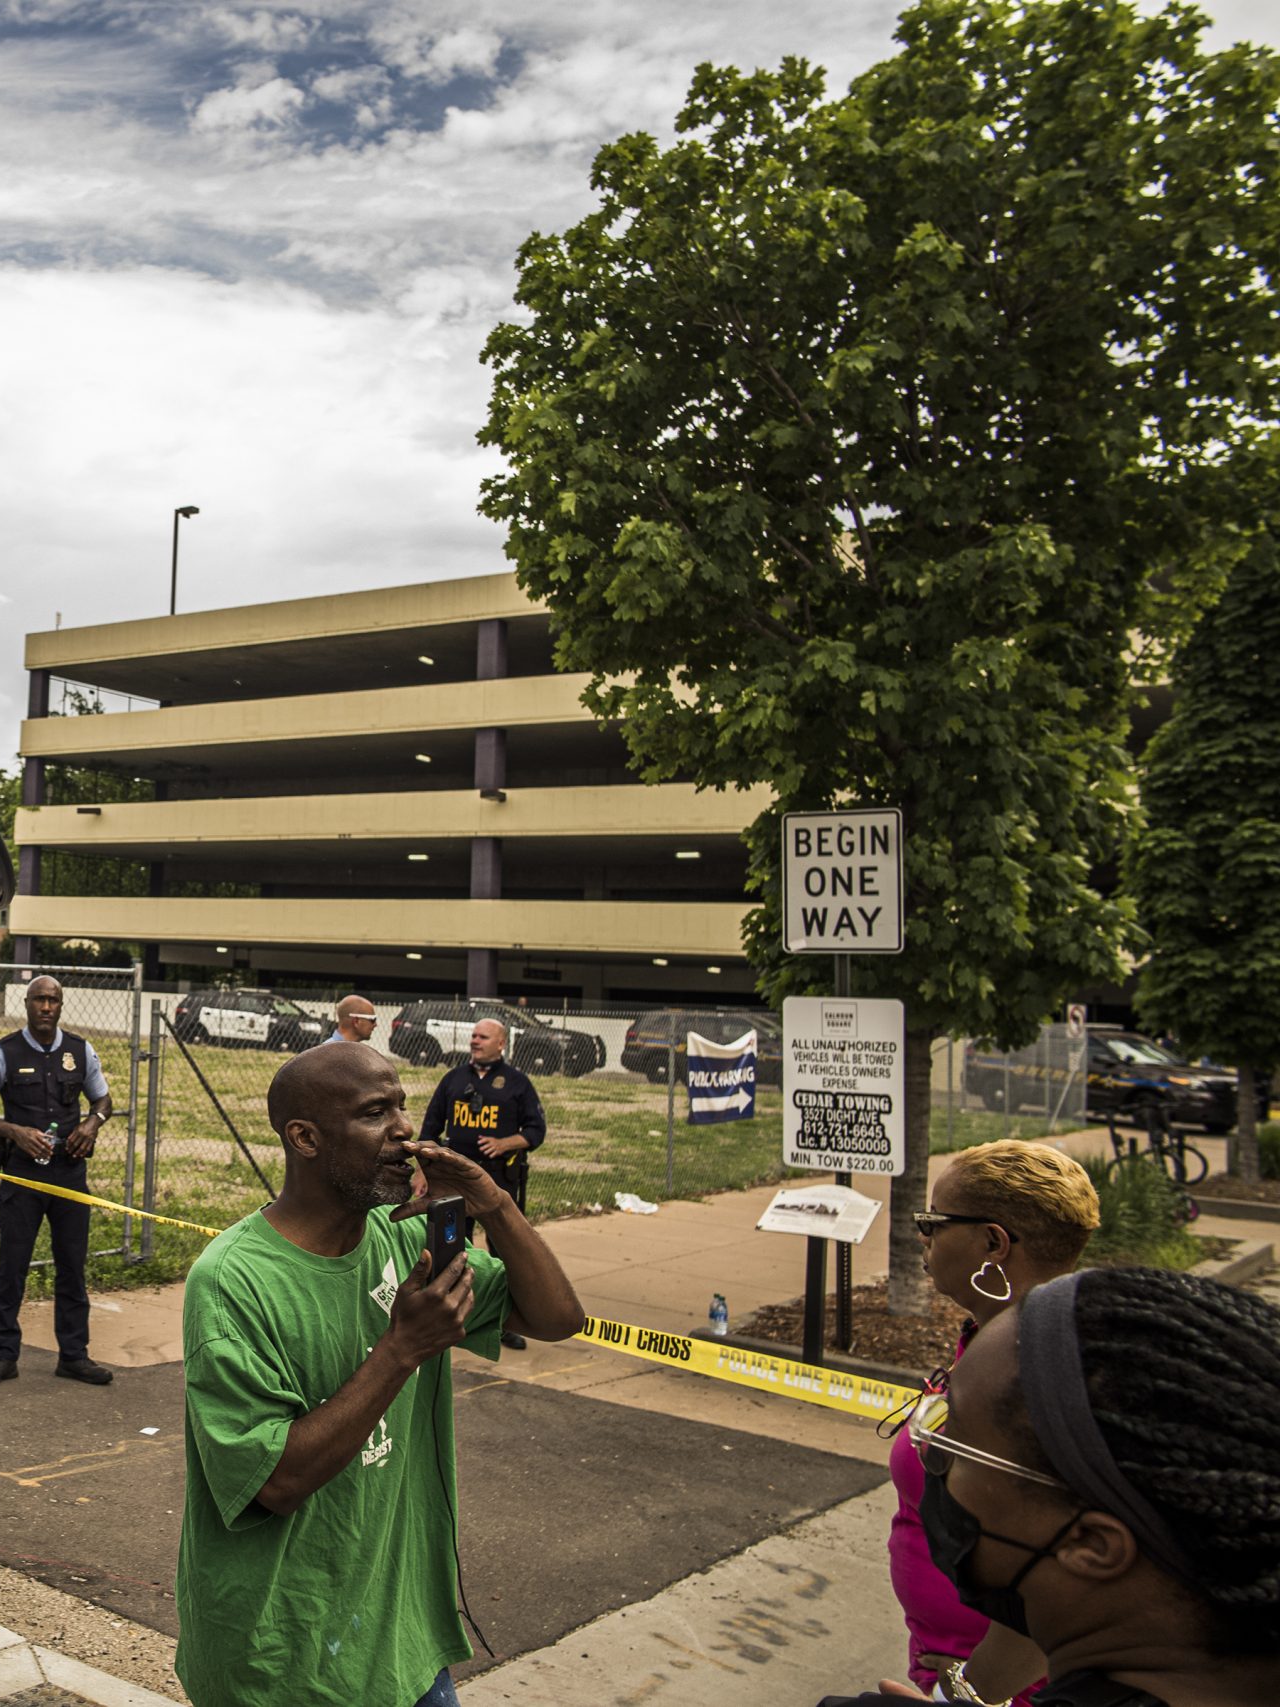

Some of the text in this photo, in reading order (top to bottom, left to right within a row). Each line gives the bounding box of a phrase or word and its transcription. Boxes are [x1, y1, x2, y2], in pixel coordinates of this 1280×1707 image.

[795, 825, 889, 857] BEGIN
[805, 866, 879, 897] ONE
[801, 906, 882, 937] WAY
[792, 1039, 897, 1053] ALL UNAUTHORIZED
[794, 1052, 894, 1066] VEHICLES WILL BE TOWED
[798, 1064, 891, 1079] AT VEHICLES OWNERS
[795, 1092, 890, 1112] CEDAR TOWING
[453, 1102, 499, 1129] POLICE
[804, 1108, 878, 1125] 3527 DIGHT AVE
[804, 1120, 883, 1138] 612-721-6645
[798, 1133, 889, 1153] Lic. # 13050008
[791, 1152, 894, 1172] MIN. TOW $220.00
[581, 1317, 693, 1361] O NOT CROSS
[717, 1347, 780, 1383] POLICE
[784, 1362, 824, 1394] LINE
[828, 1373, 854, 1401] DO
[859, 1380, 897, 1412] NOT
[361, 1438, 393, 1467] RESIST
